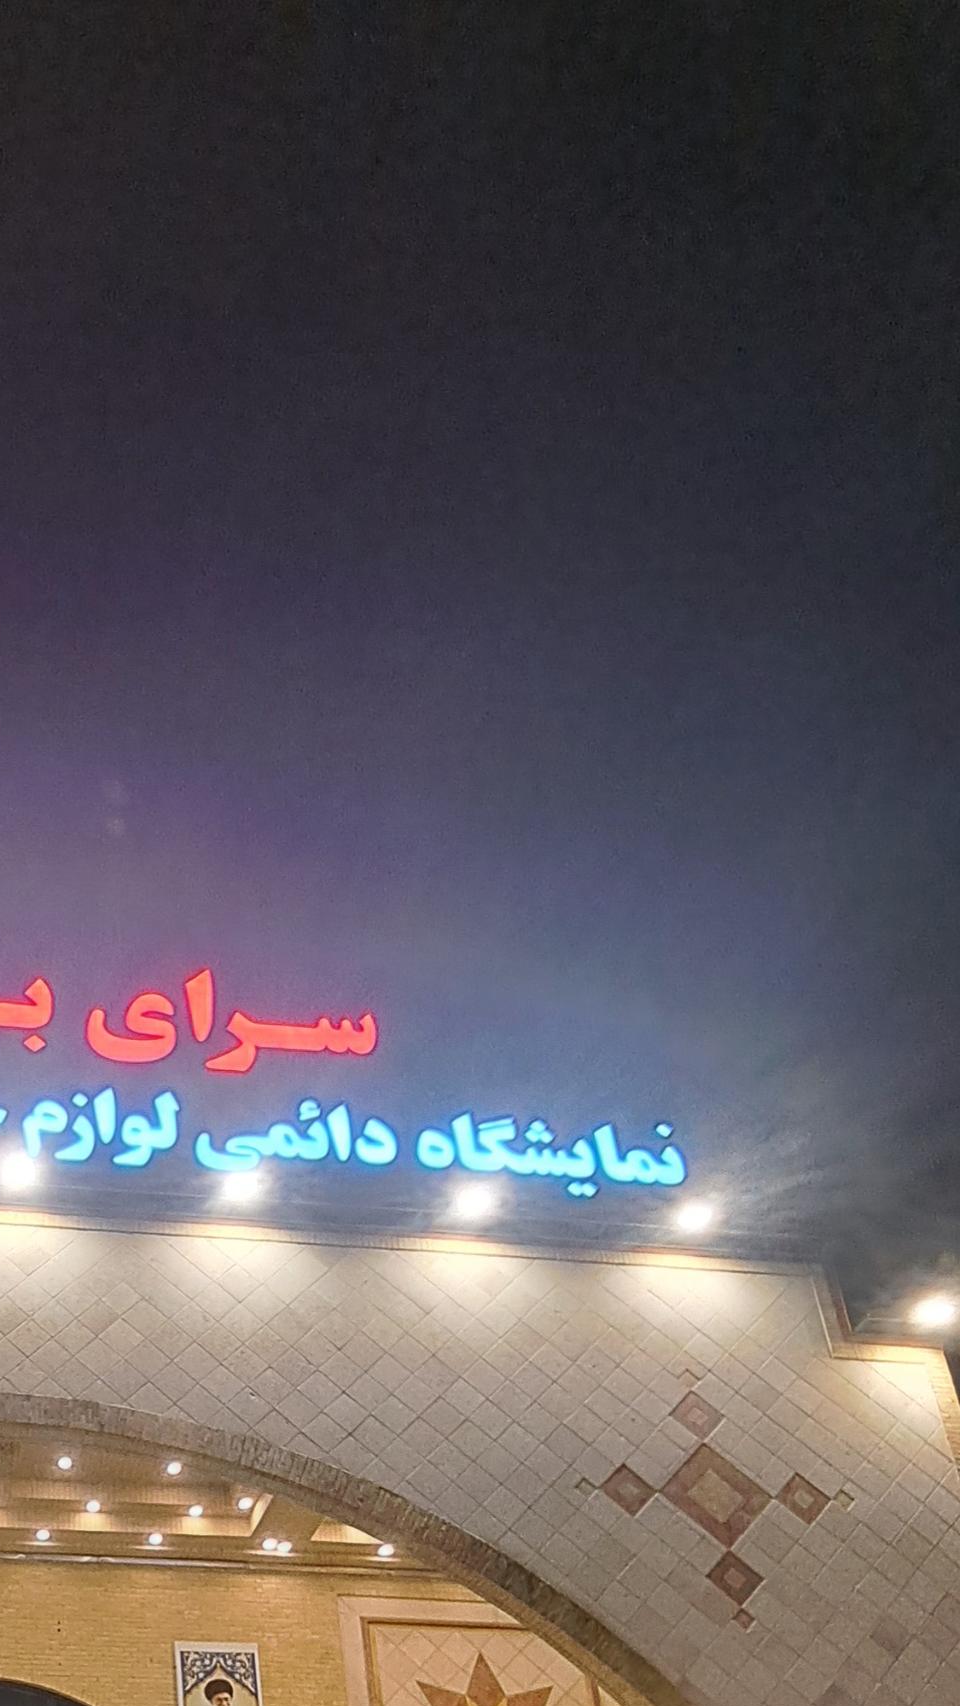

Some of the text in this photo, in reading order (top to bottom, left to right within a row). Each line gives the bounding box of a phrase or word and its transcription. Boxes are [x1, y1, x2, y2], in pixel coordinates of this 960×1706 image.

[86, 968, 378, 1074] سرای
[22, 1086, 181, 1170] لوازم
[193, 1098, 399, 1173] دائمی
[415, 1108, 688, 1198] نمایشگاه
